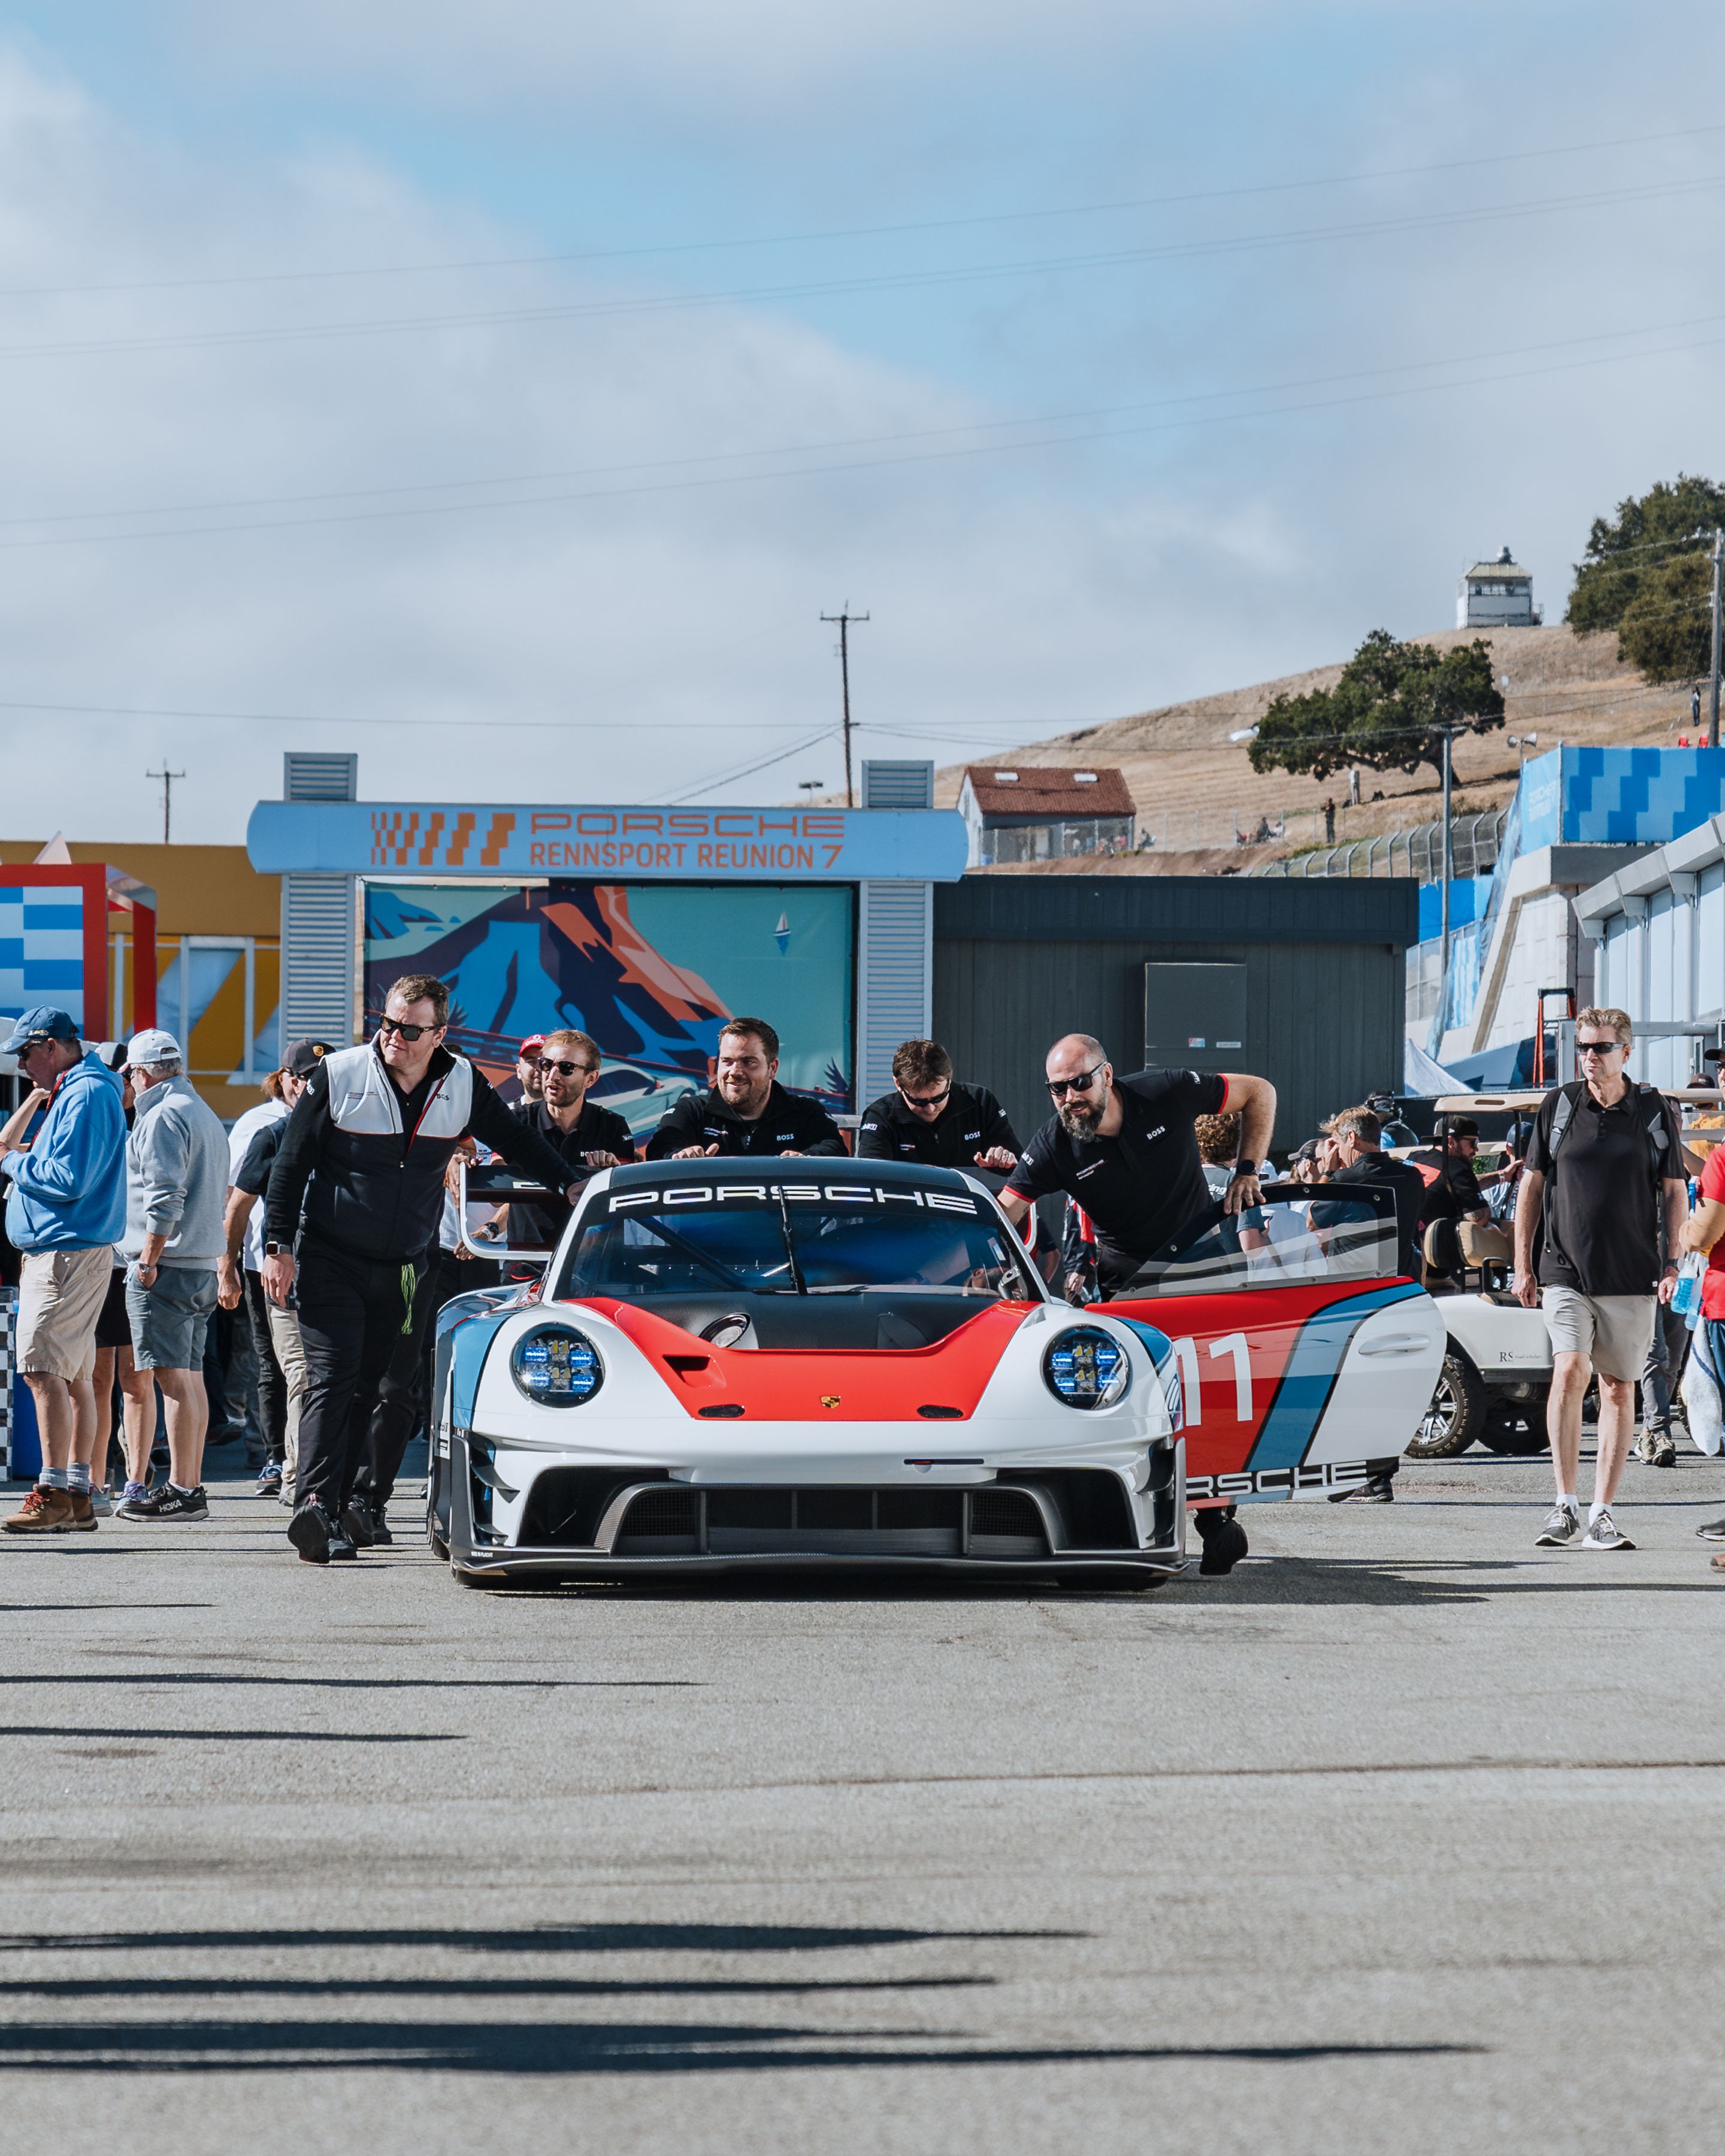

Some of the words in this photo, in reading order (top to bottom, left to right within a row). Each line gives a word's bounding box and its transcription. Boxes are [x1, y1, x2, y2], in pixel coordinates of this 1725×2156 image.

[531, 813, 845, 837] PORSCHE
[531, 842, 688, 867] RENNSPORT
[698, 843, 813, 869] REUNION
[822, 844, 843, 869] 7
[777, 1133, 794, 1141] BOSS
[609, 1185, 978, 1215] PORSCHE
[158, 1499, 182, 1513] HOKA
